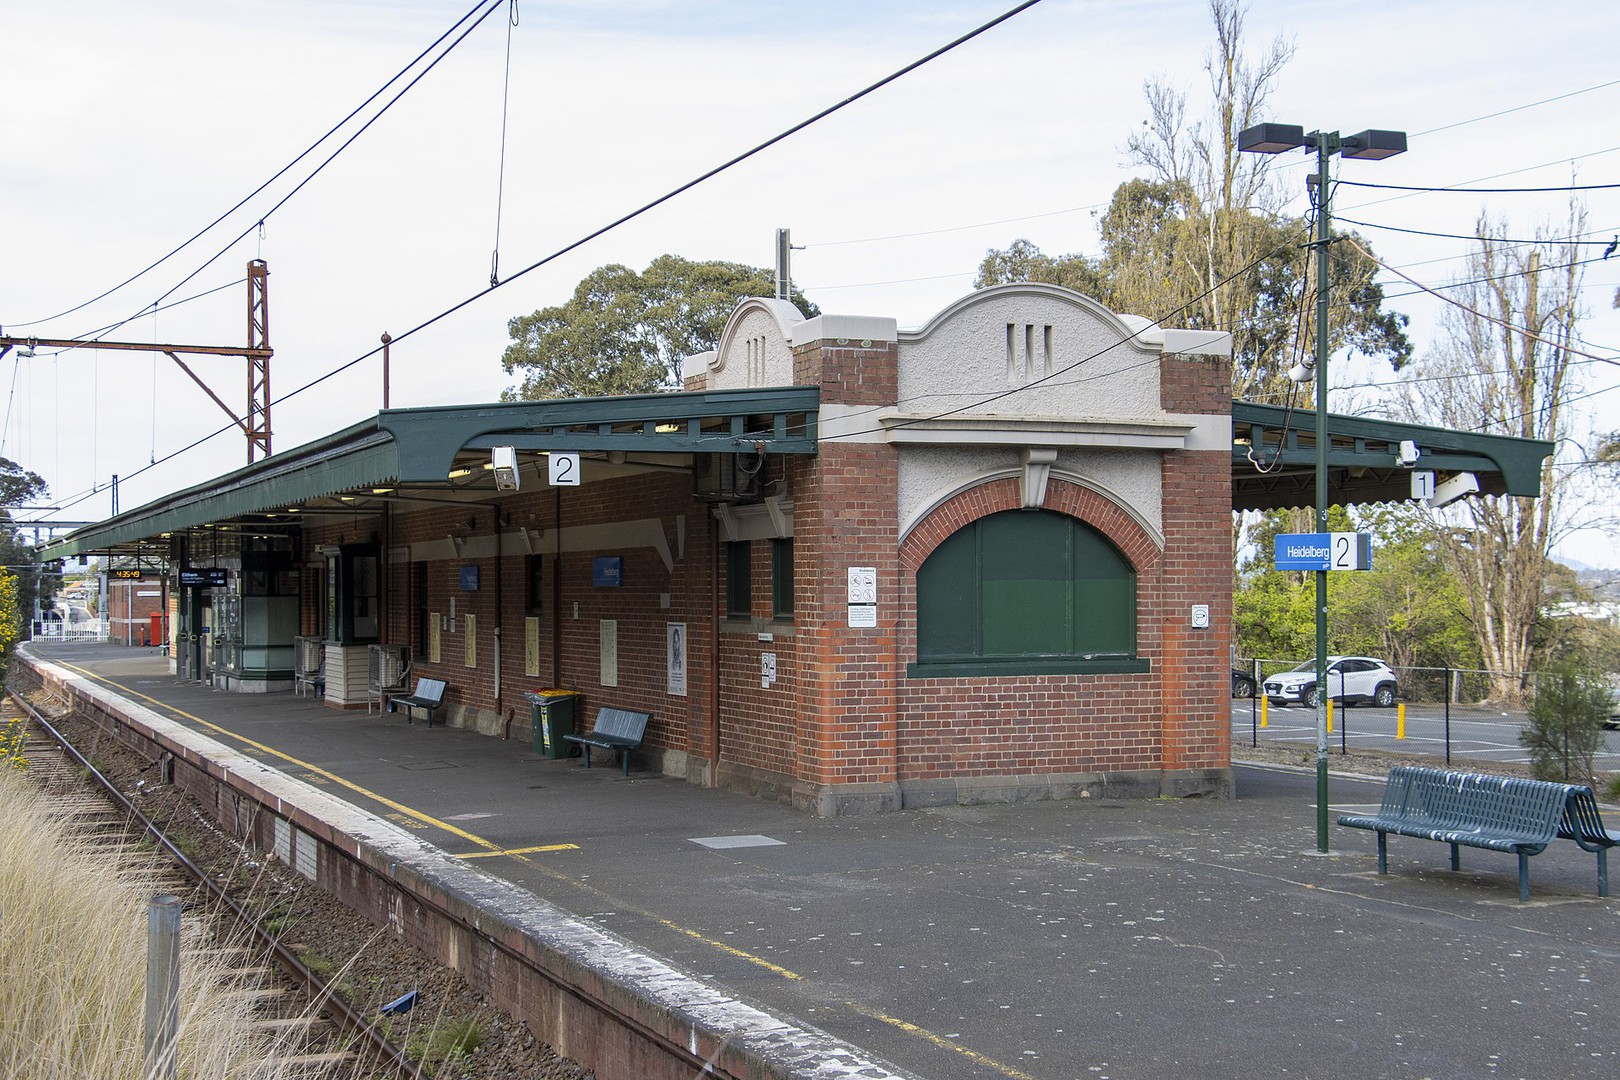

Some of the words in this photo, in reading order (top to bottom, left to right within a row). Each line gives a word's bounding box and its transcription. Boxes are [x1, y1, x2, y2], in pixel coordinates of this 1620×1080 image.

[556, 456, 573, 483] 2
[1418, 474, 1426, 497] 1
[1287, 545, 1330, 561] Heidelberg
[1336, 537, 1349, 567] 2
